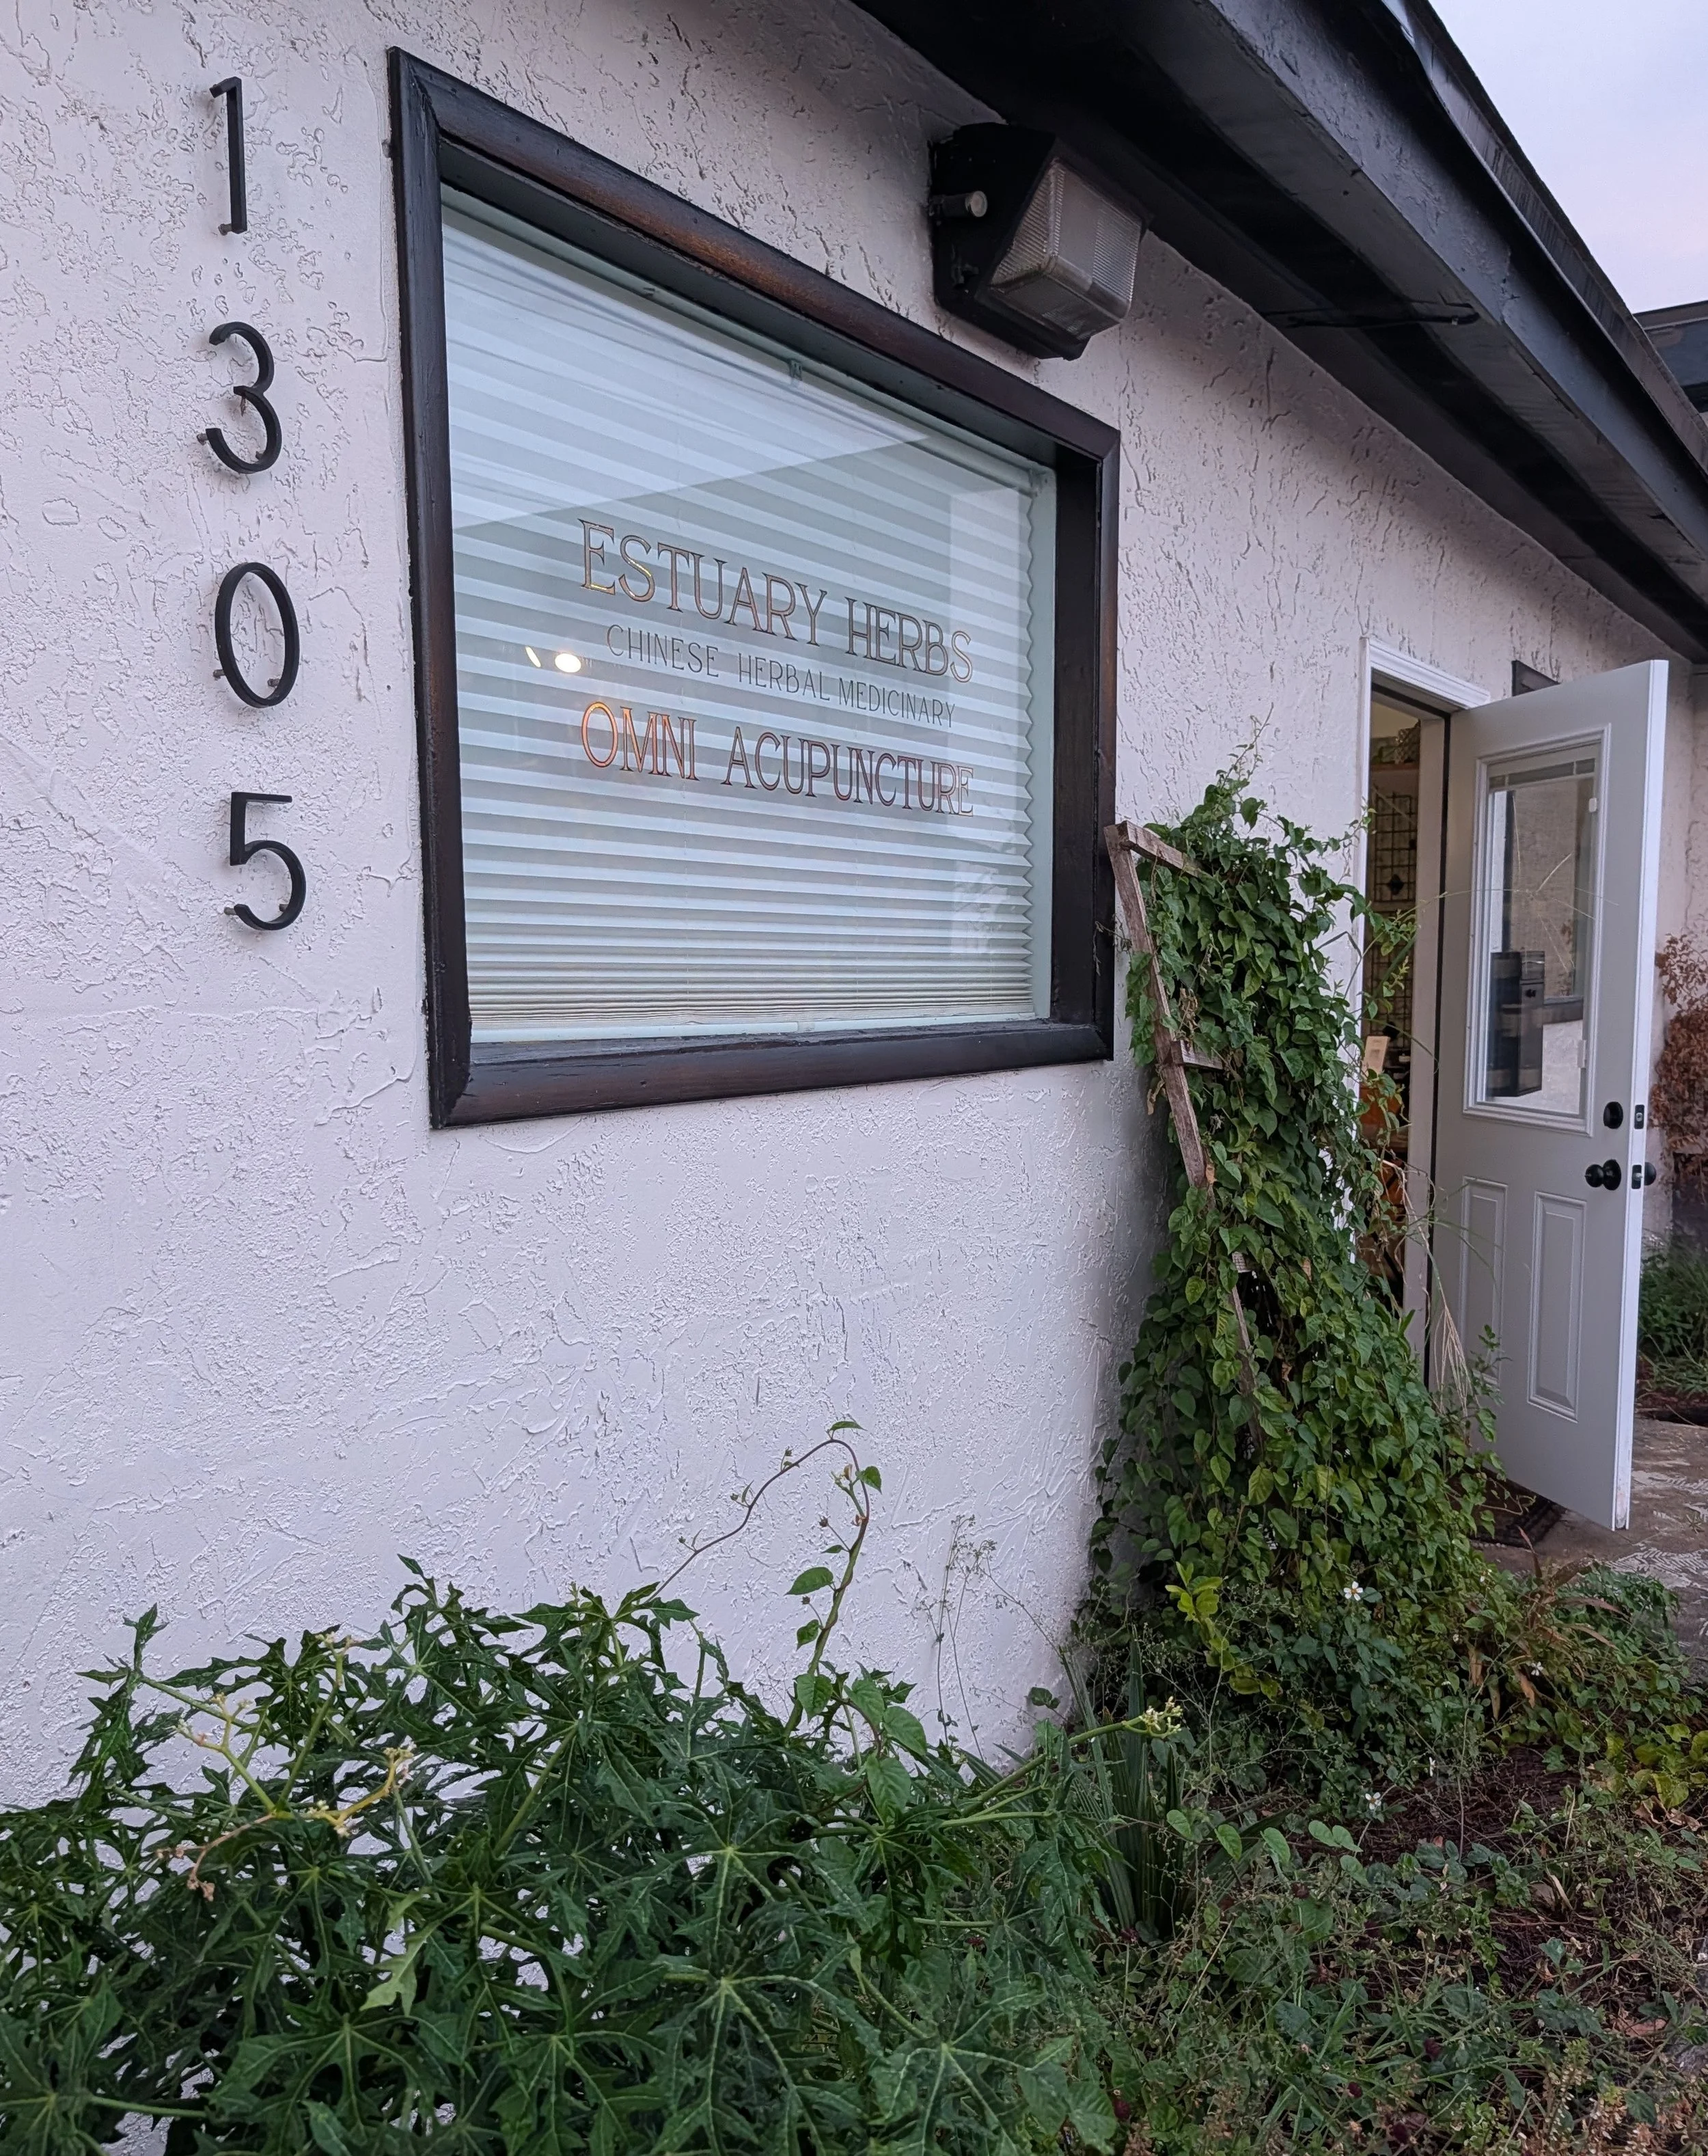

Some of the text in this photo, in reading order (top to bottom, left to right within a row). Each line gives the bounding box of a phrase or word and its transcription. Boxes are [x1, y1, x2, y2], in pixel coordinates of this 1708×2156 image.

[206, 77, 307, 933] 1305
[577, 518, 973, 683] ESTUARY HERBS
[607, 624, 956, 728] CHINESE HERBAL MEDICINARY
[581, 702, 974, 817] OMNI ACUPUNCTURE
